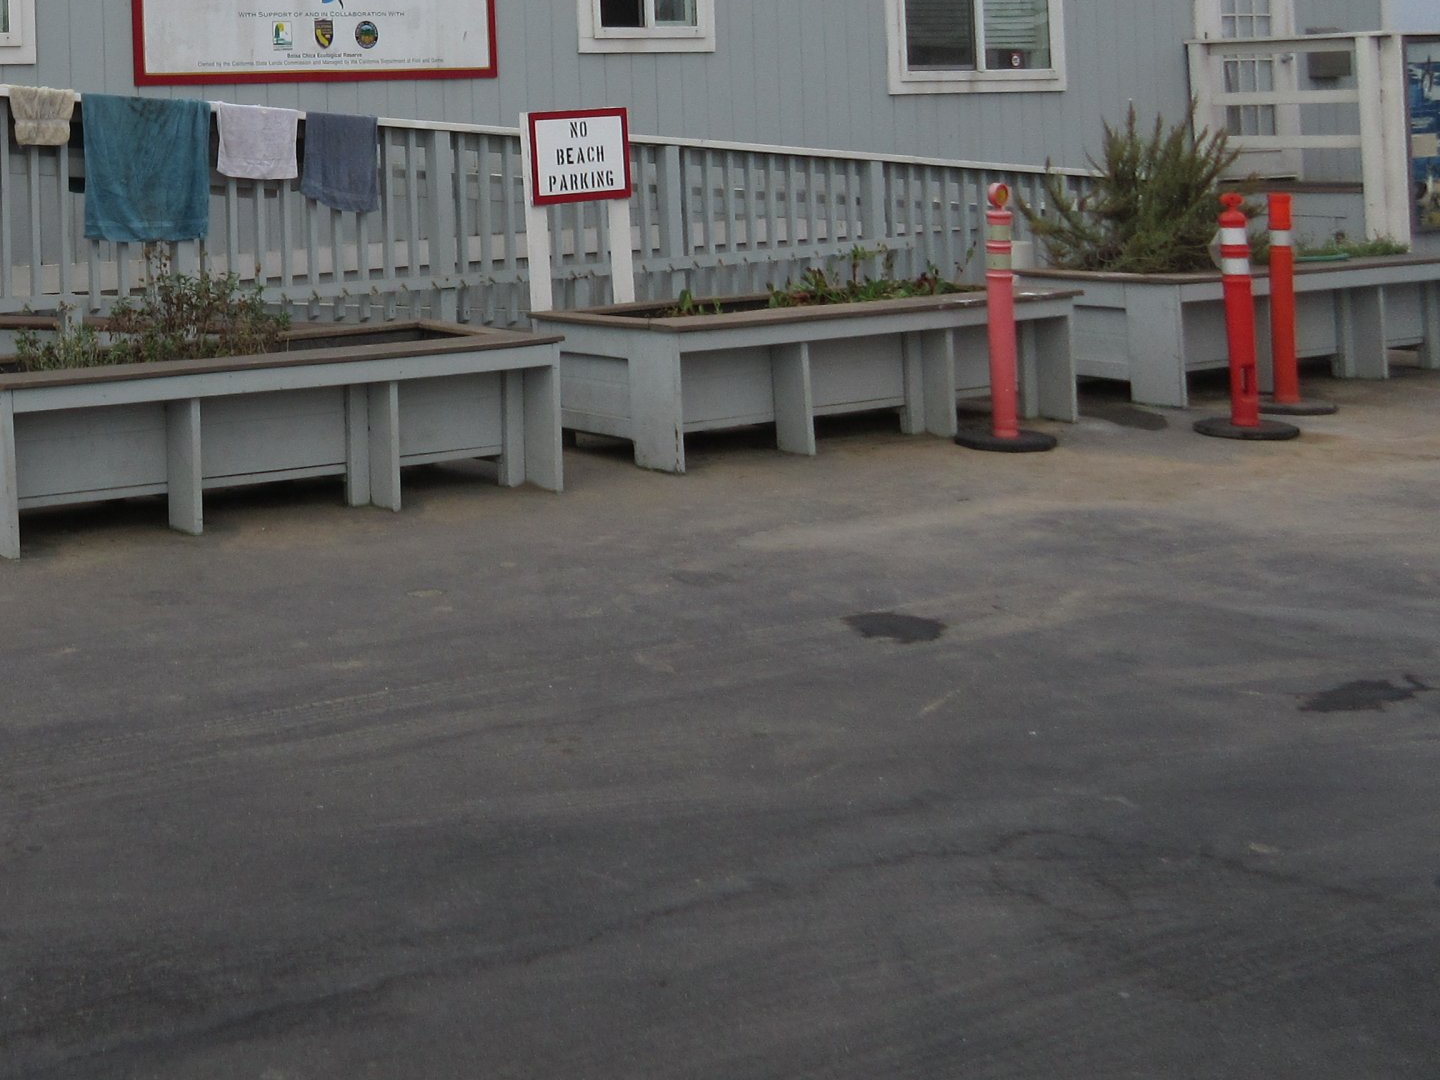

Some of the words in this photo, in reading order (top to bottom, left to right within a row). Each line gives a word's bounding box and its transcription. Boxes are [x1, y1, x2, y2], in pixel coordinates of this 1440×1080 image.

[569, 121, 588, 138] NO
[556, 145, 605, 166] BEACH
[548, 170, 614, 192] PARKING
